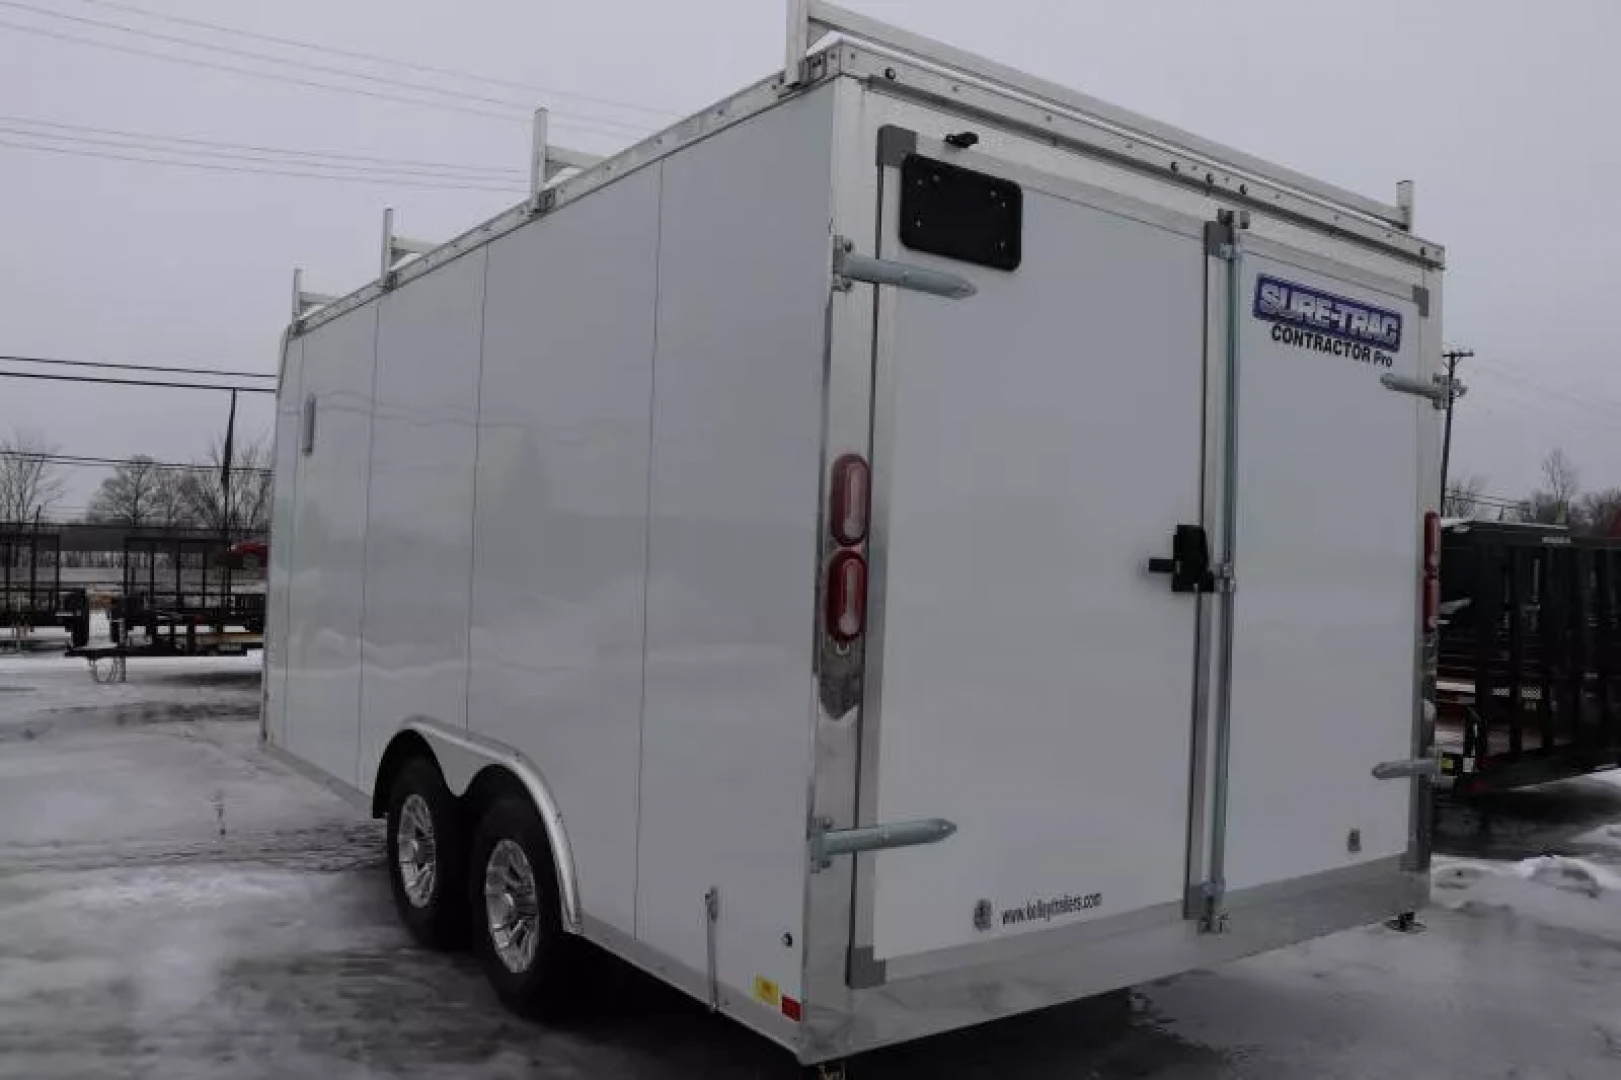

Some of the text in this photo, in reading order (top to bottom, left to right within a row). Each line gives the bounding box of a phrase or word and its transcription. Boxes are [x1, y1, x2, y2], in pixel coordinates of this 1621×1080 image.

[1258, 282, 1400, 347] SURE-TRAC
[1271, 323, 1393, 368] CONTRACTOR Pro
